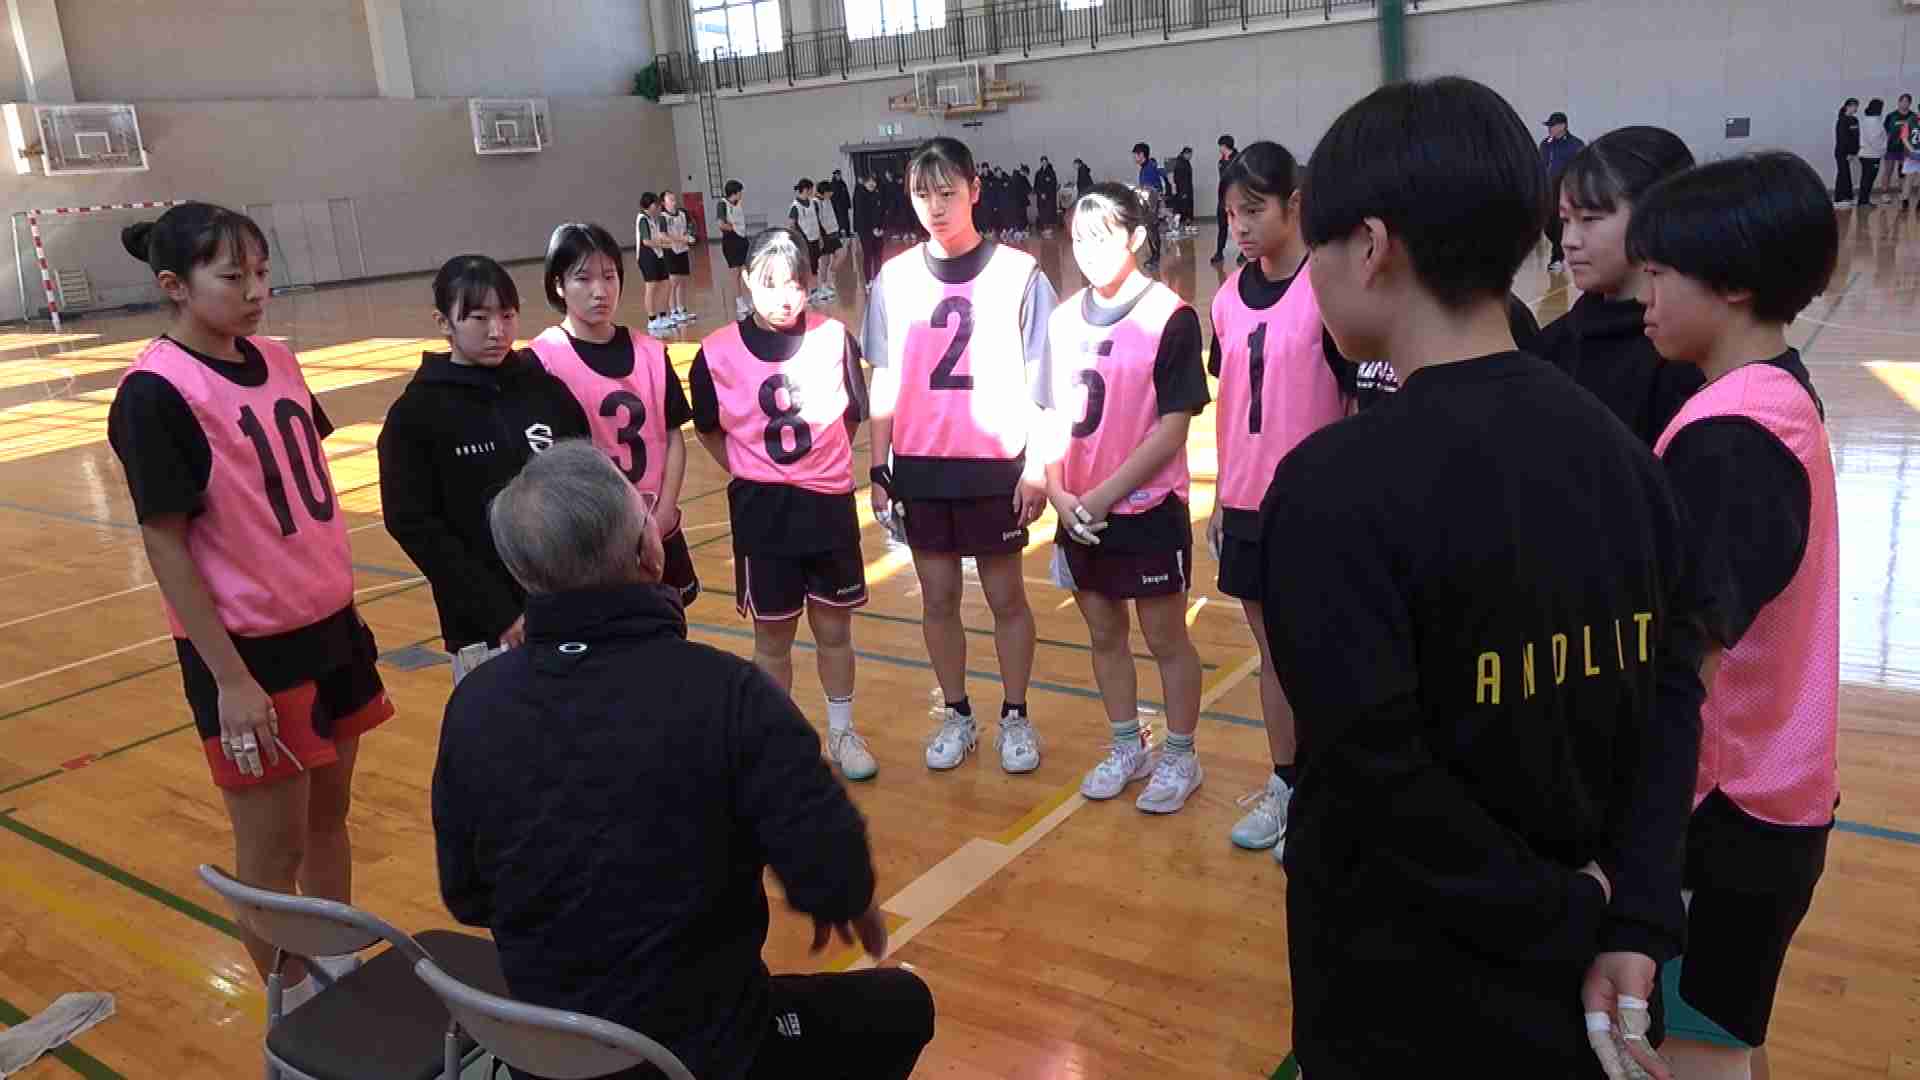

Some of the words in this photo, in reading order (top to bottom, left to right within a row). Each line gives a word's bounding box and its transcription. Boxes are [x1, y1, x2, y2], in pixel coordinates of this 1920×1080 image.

[929, 295, 975, 391] 2
[1071, 339, 1115, 439] 5
[1247, 321, 1268, 435] 1
[236, 397, 334, 537] 10
[599, 390, 647, 484] 3
[758, 373, 812, 466] 8
